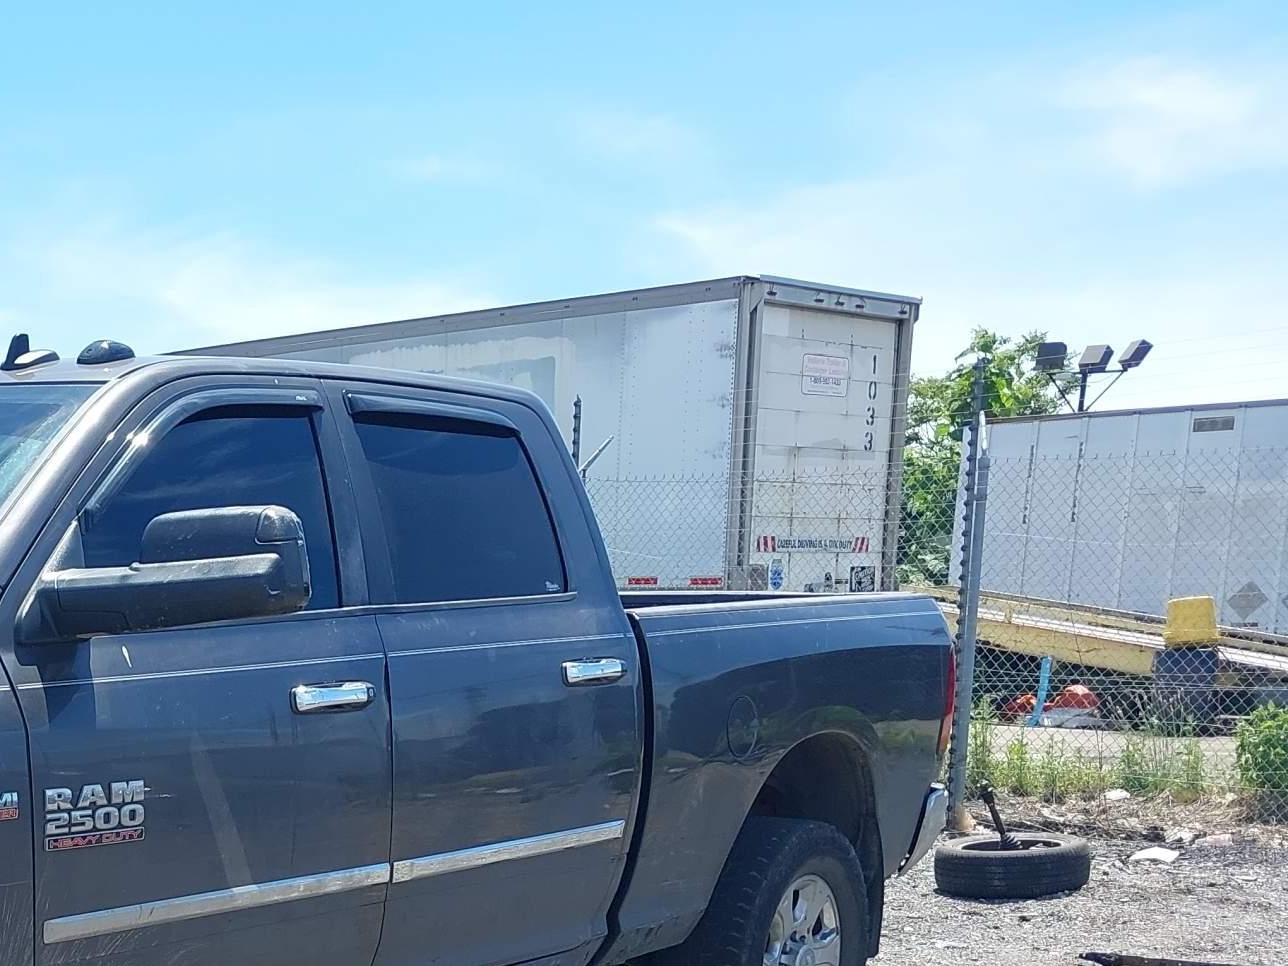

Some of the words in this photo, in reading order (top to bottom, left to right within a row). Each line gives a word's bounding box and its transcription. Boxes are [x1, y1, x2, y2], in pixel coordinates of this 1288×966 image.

[45, 780, 145, 811] RAM
[45, 804, 145, 835] 2500
[50, 834, 100, 849] HEAVY
[102, 829, 141, 843] DUTY
